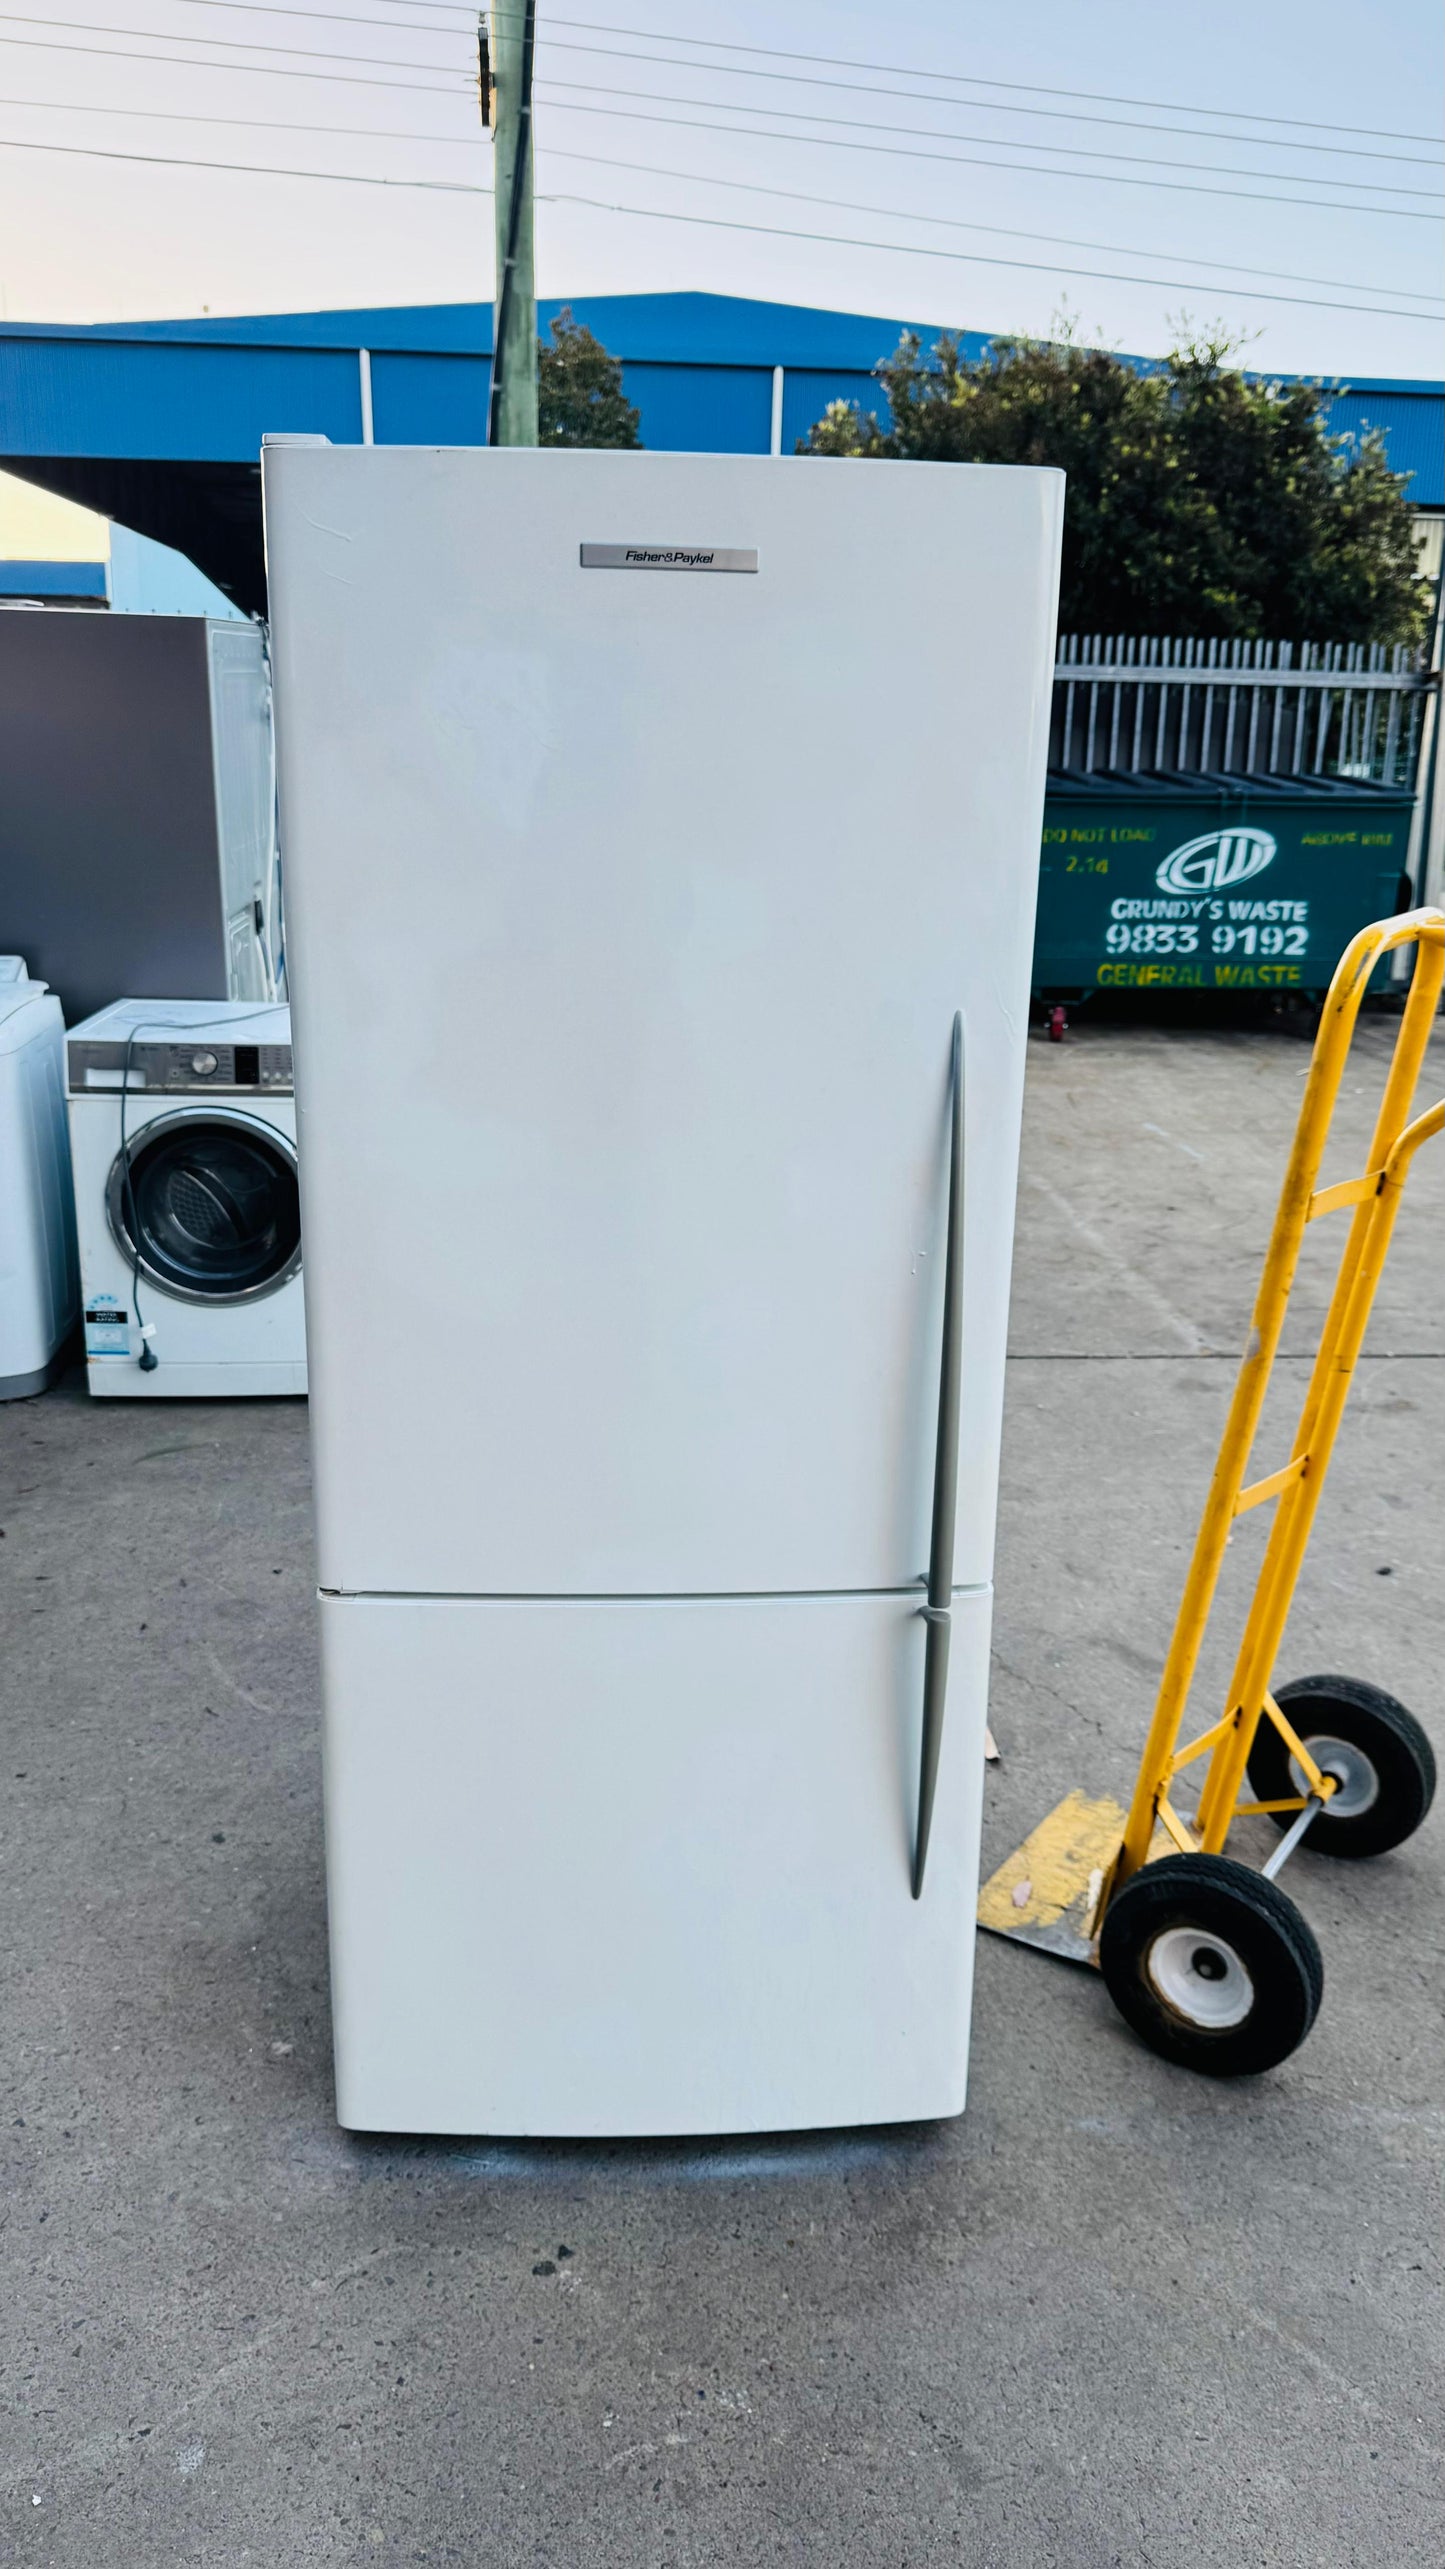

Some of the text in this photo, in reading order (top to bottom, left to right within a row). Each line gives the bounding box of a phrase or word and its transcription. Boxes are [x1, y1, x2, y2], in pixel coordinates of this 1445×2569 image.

[625, 550, 714, 566] Fisher&Paykel
[1071, 828, 1106, 843] NOT
[1110, 897, 1309, 922] GRUNDY'S WASTE
[1106, 923, 1309, 956] 9833 9192
[1096, 963, 1303, 988] GENERAL WASTE
